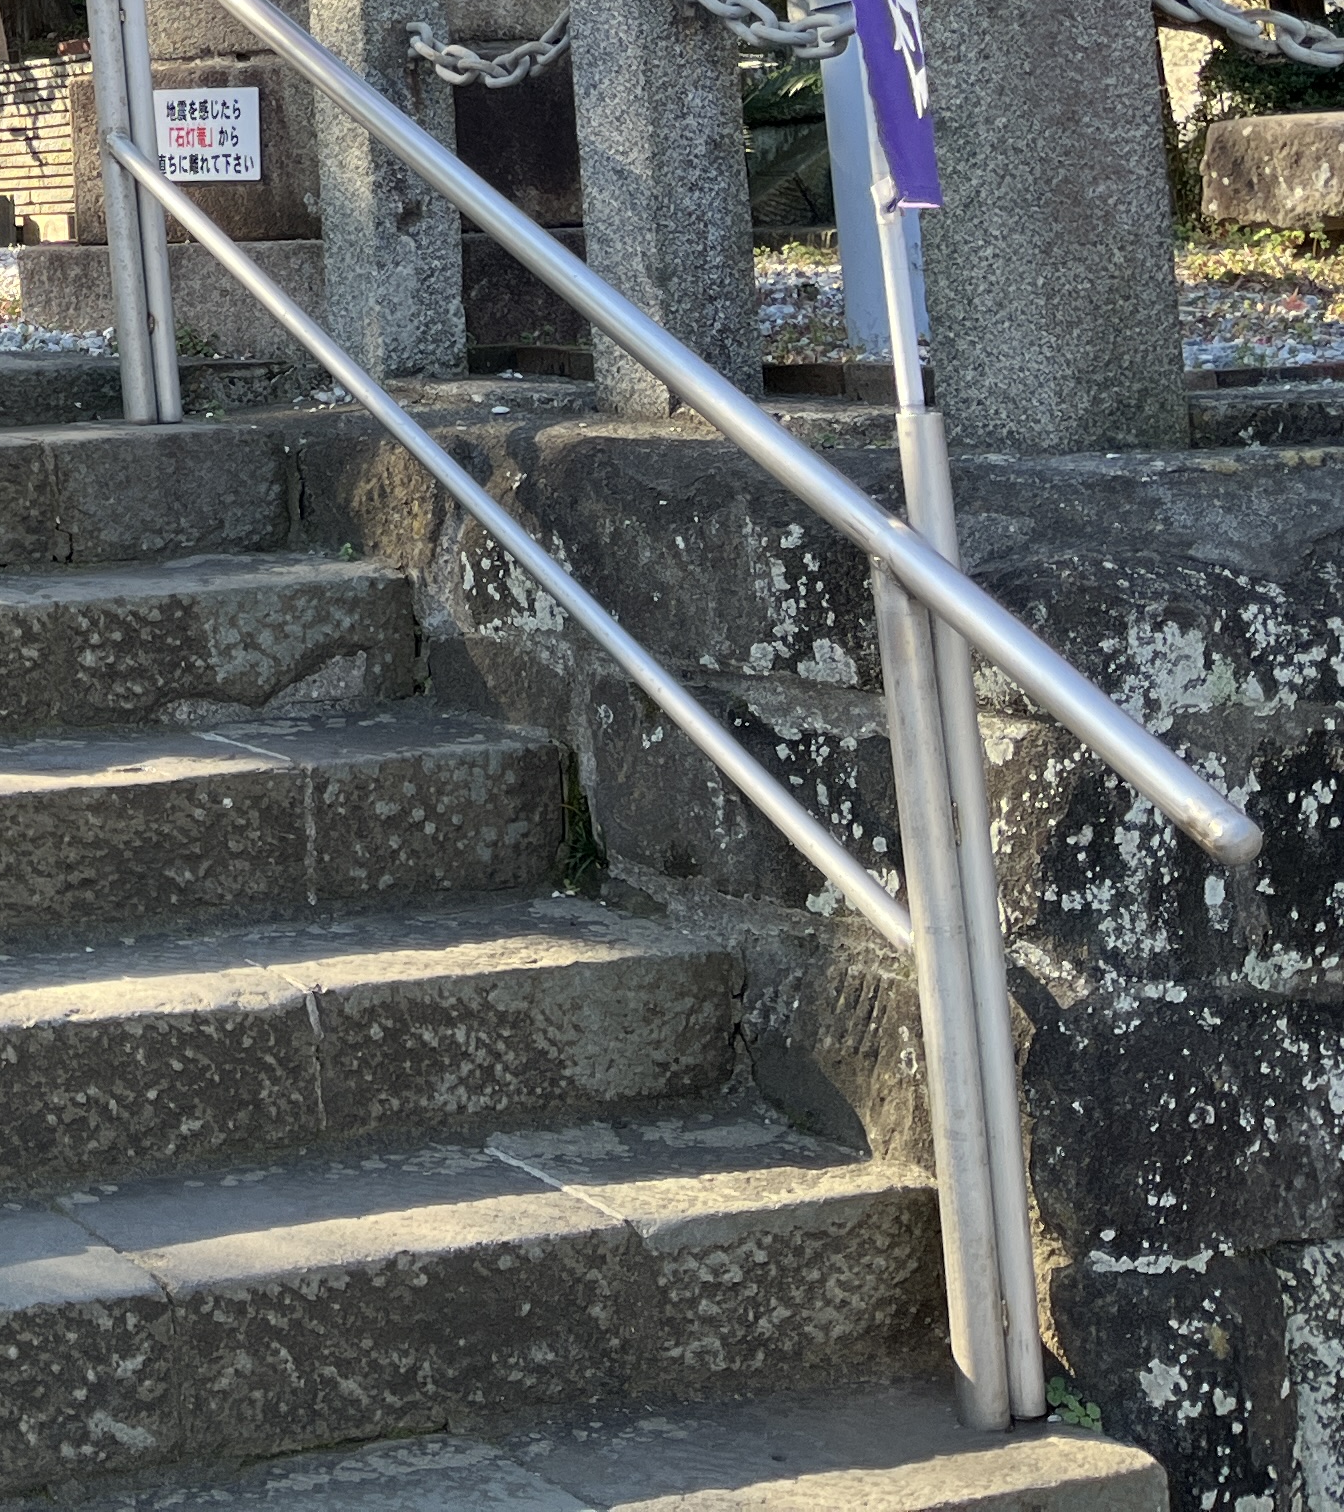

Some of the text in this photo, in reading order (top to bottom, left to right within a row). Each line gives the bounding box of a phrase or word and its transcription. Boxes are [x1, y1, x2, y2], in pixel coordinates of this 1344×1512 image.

[166, 99, 242, 121] 地震を感じたら
